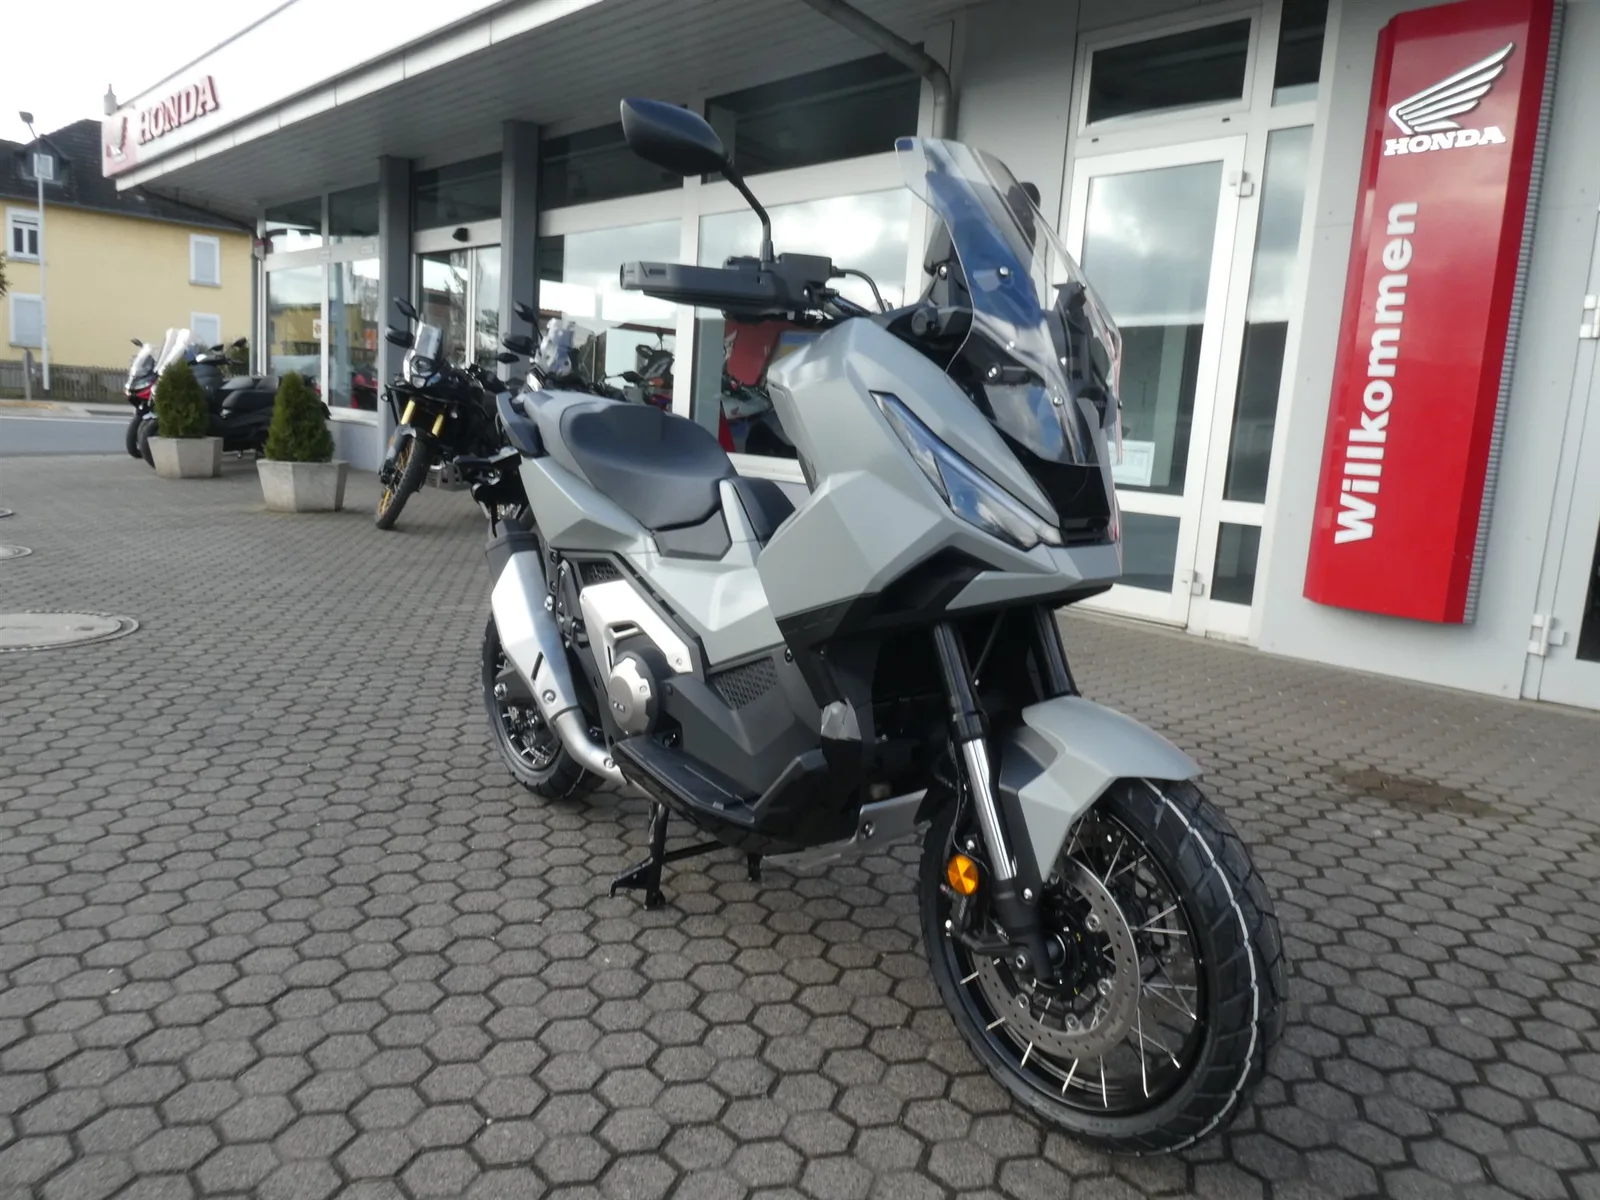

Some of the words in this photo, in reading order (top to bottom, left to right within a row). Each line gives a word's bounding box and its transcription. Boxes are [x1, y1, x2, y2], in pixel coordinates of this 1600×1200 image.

[138, 75, 219, 145] HONDA
[1383, 126, 1506, 156] HONDA
[1334, 202, 1418, 544] Willkommen
